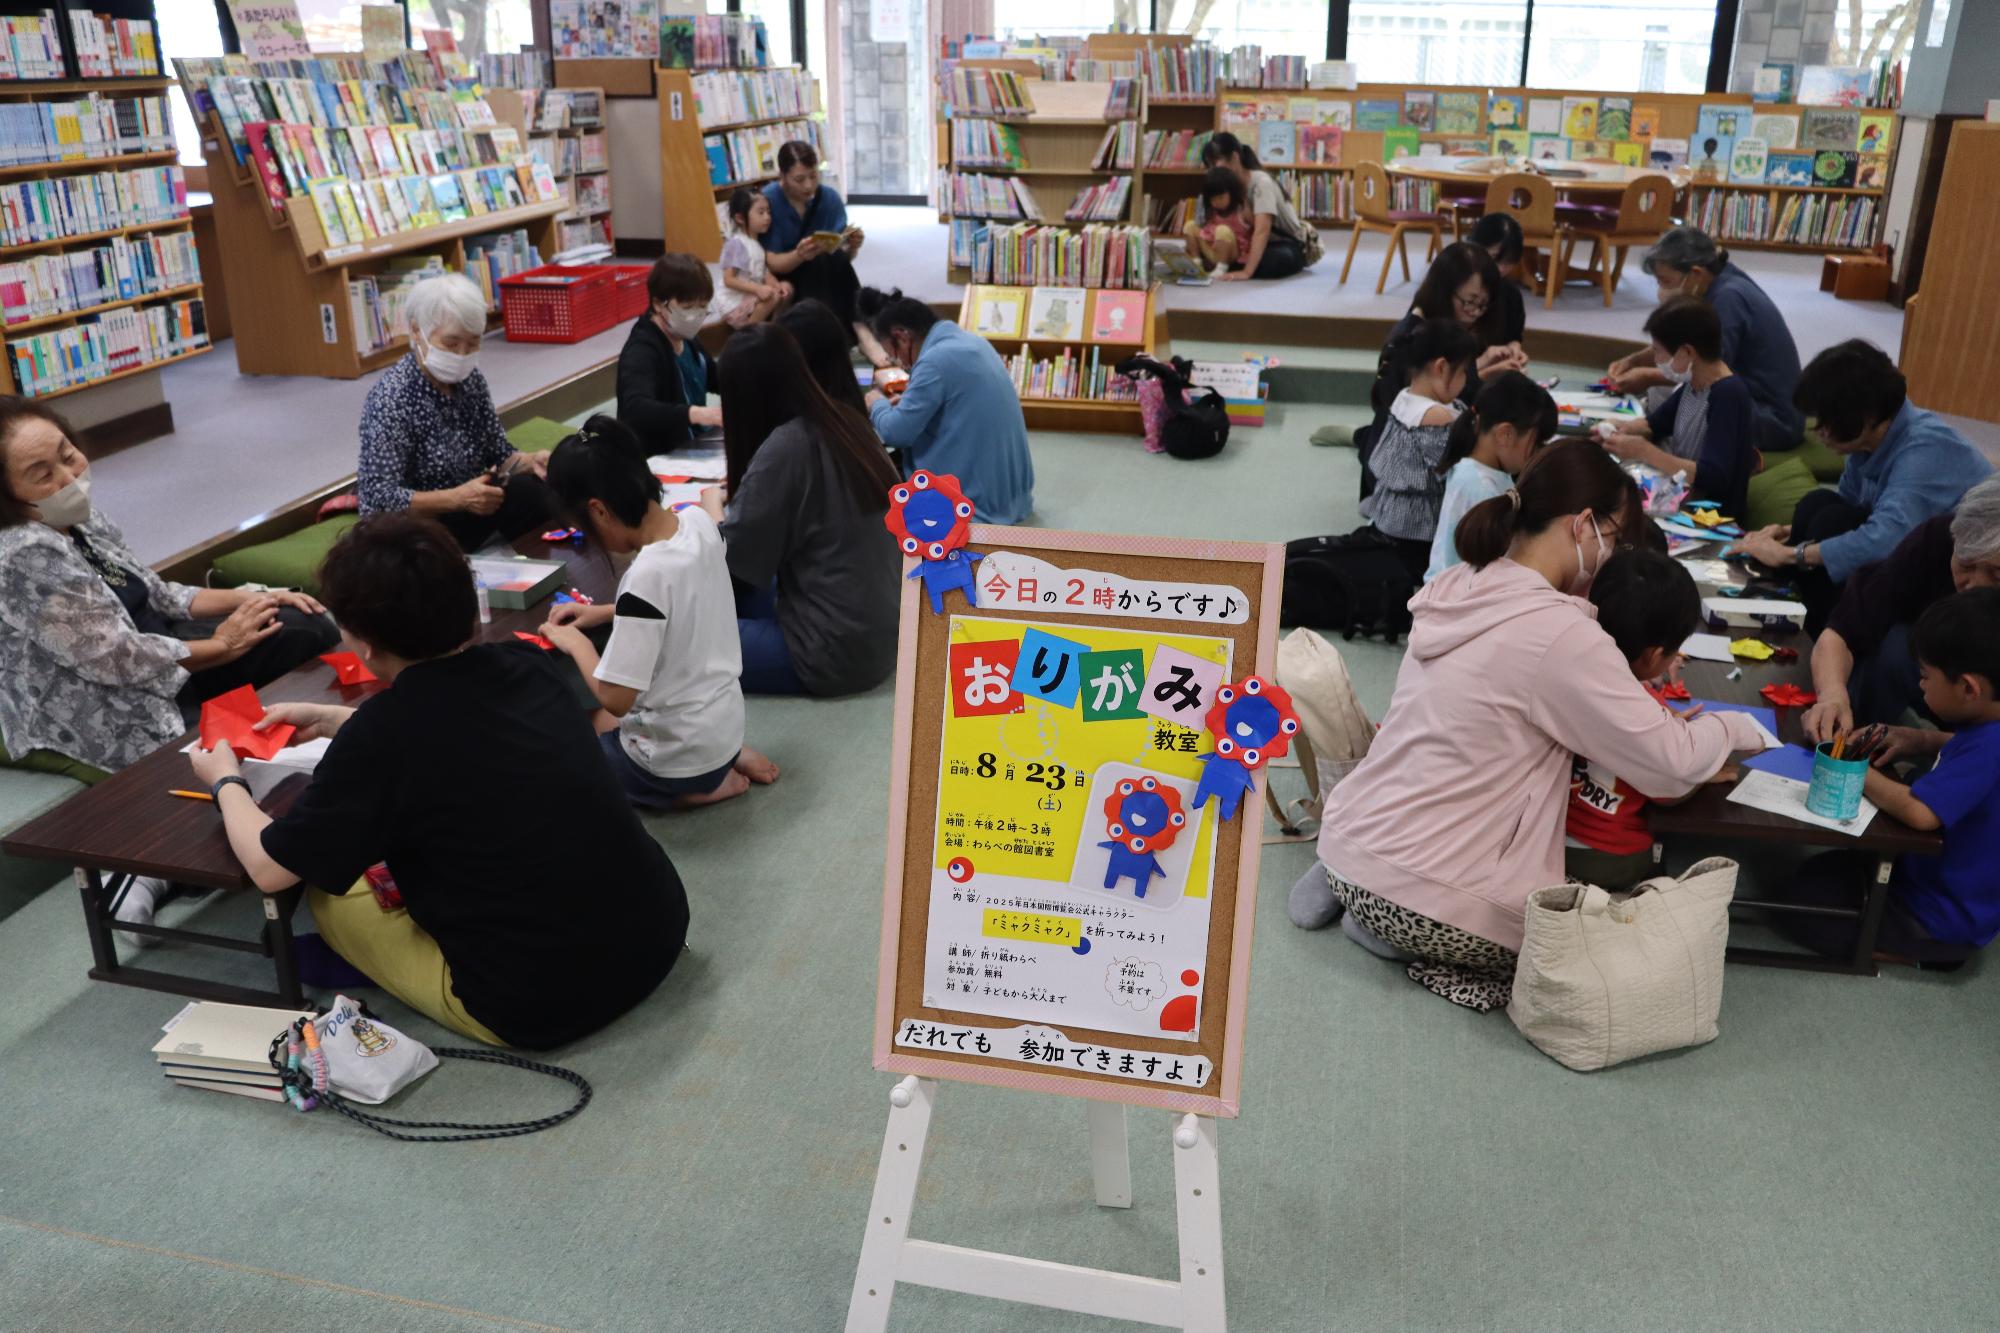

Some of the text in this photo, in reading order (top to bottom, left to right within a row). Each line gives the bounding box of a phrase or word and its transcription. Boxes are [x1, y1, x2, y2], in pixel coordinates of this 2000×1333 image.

[964, 646, 1202, 713] おりがみ
[1154, 728, 1200, 753] 教室
[904, 1022, 991, 1054] だれでも
